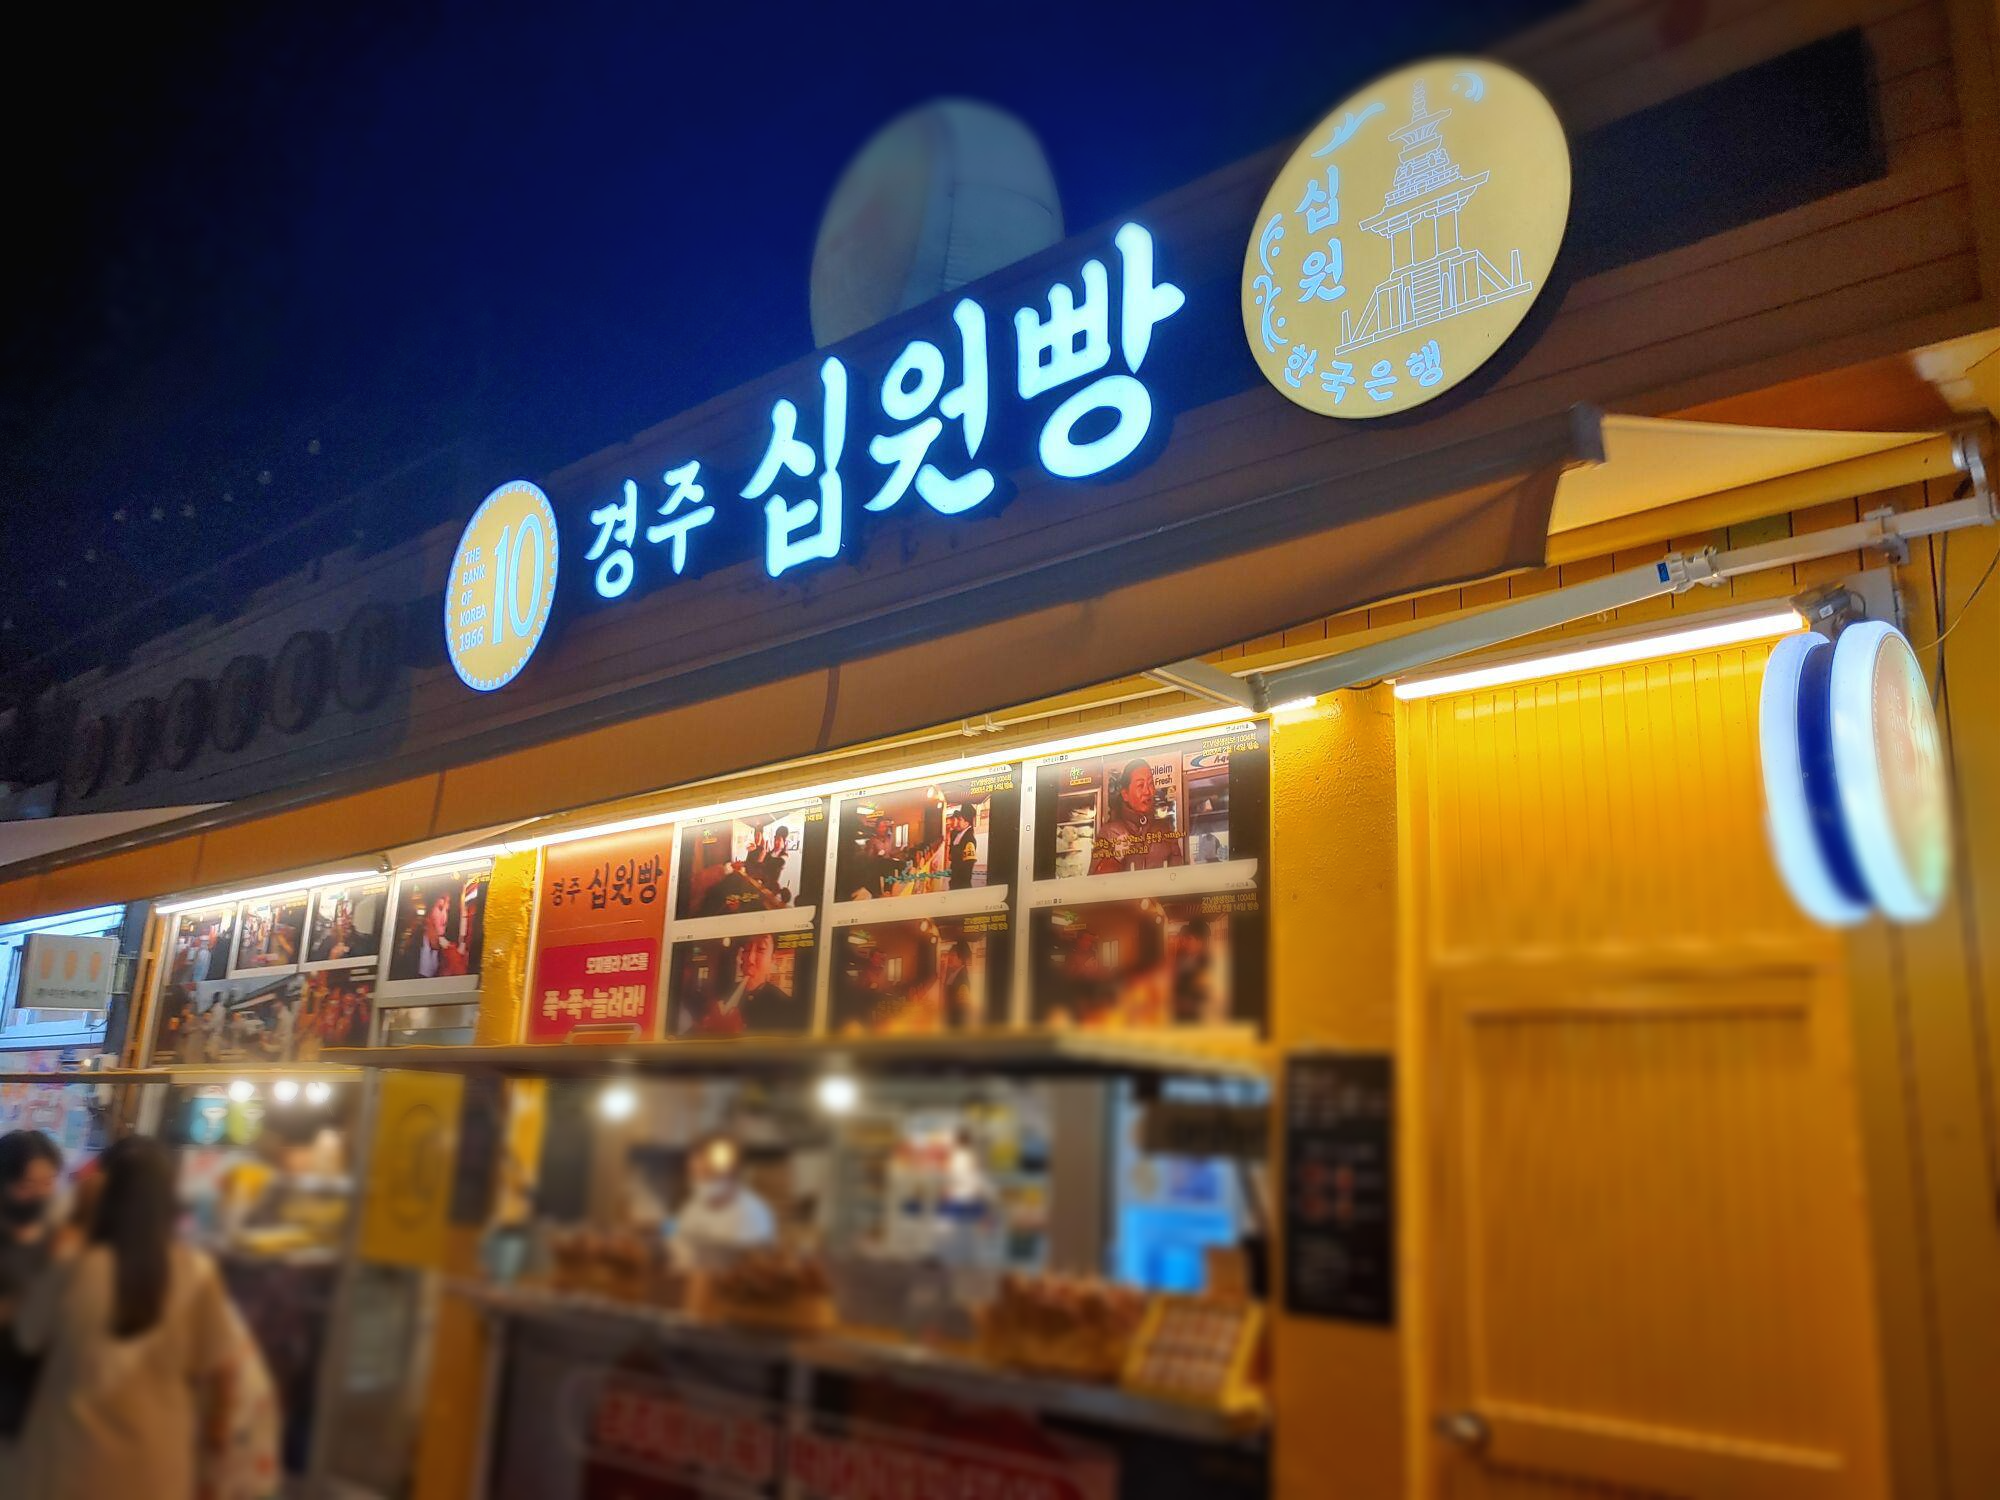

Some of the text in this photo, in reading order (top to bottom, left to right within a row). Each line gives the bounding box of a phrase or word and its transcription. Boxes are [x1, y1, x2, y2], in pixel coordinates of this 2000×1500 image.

[1295, 164, 1347, 303] 십원
[1284, 339, 1445, 405] 한국은행
[585, 220, 1187, 599] 경주 십원빵
[463, 566, 486, 586] BANK
[464, 546, 481, 566] THE
[461, 589, 473, 606] OF
[492, 513, 544, 645] 10
[459, 604, 487, 628] KOREA
[459, 625, 485, 653] 1966
[549, 854, 663, 910] 경주 십원빵
